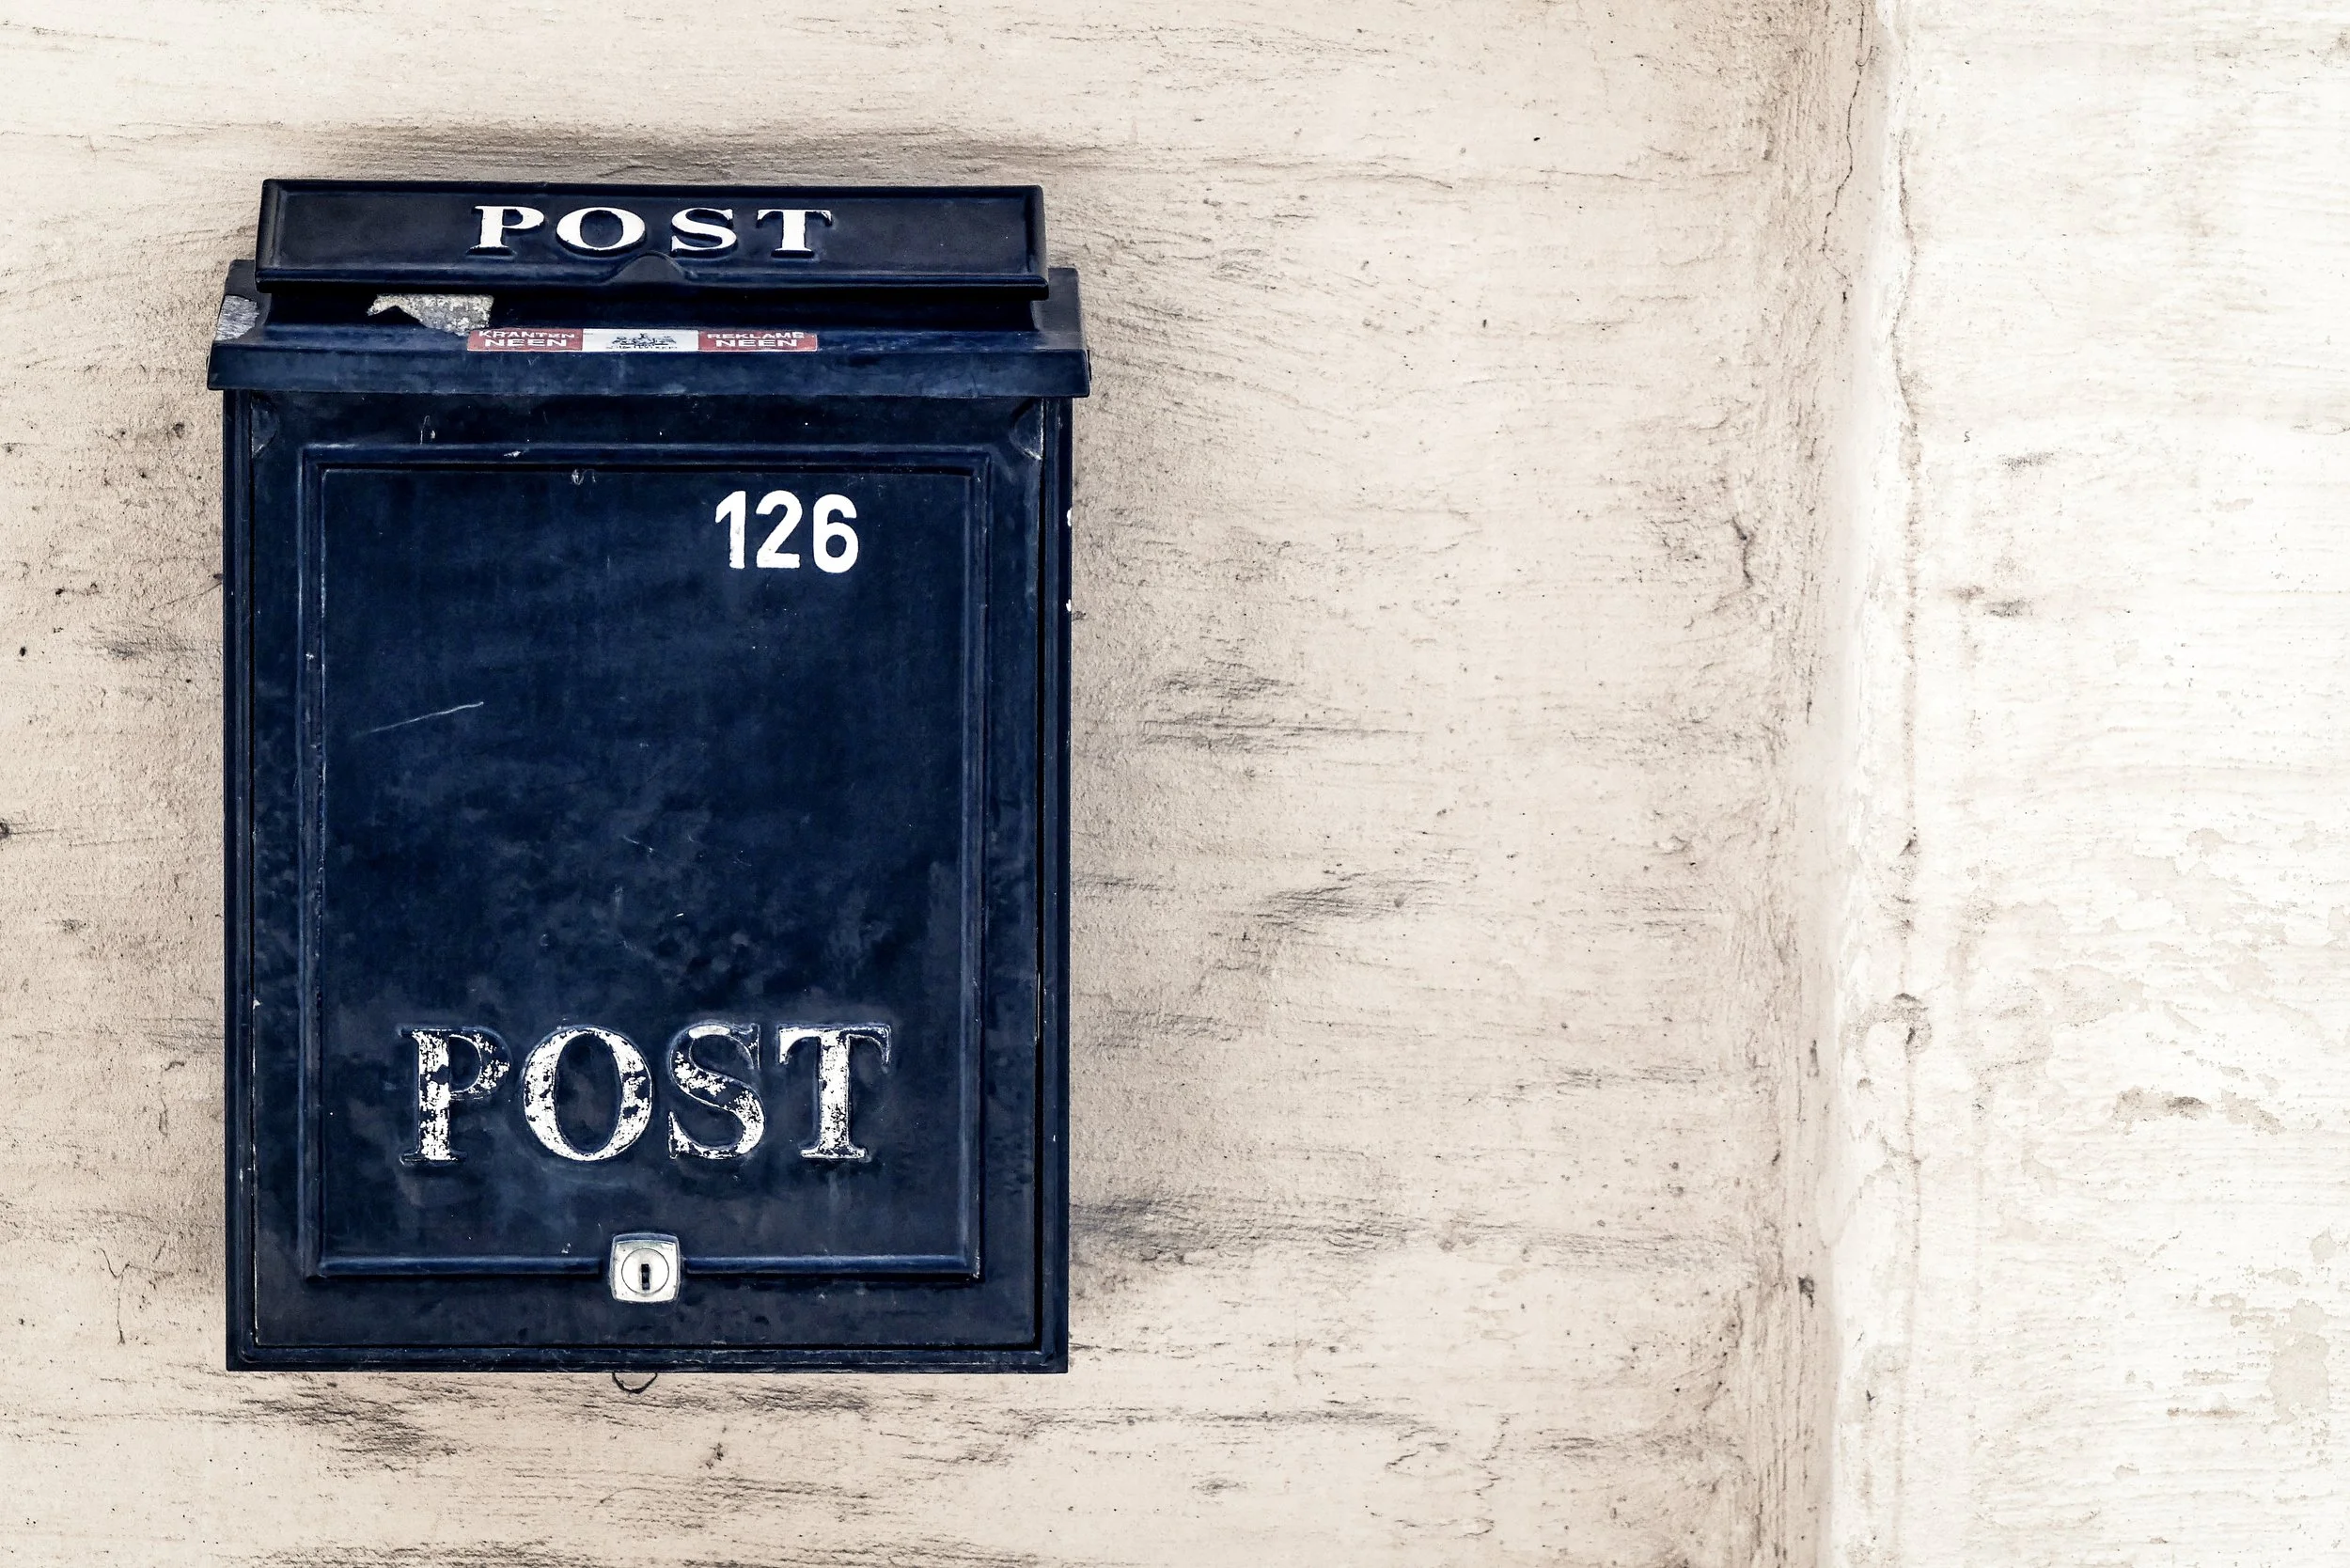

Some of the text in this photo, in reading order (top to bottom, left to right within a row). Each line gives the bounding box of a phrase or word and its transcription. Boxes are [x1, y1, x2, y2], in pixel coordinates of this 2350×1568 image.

[468, 203, 835, 258] POST
[714, 490, 859, 573] 126
[397, 1021, 894, 1165] POST
